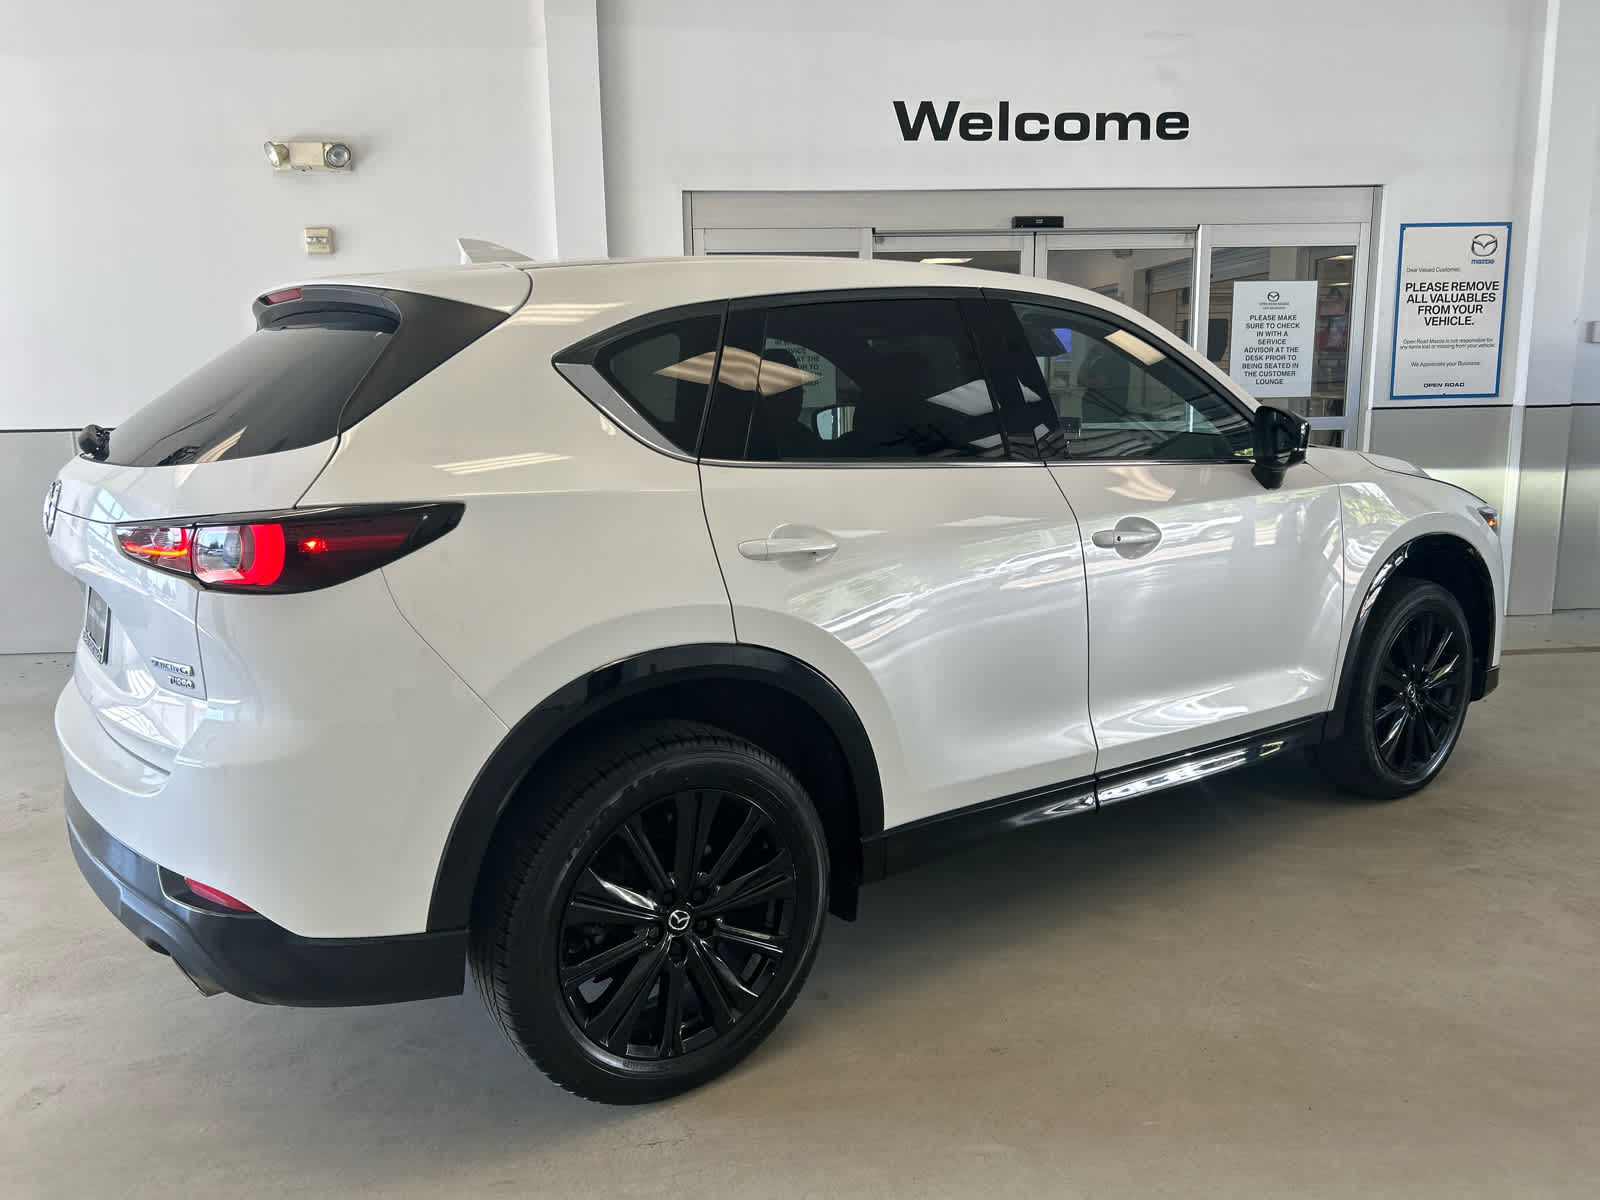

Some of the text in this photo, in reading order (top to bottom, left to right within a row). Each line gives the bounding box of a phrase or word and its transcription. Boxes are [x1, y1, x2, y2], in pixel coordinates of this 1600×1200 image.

[893, 100, 1189, 142] Welcome
[1405, 280, 1500, 292] PLEASE REMOVE
[1406, 292, 1496, 304] ALL VALUABLES
[1418, 304, 1483, 315] FROM YOUR
[1424, 316, 1474, 326] VEHICLE.
